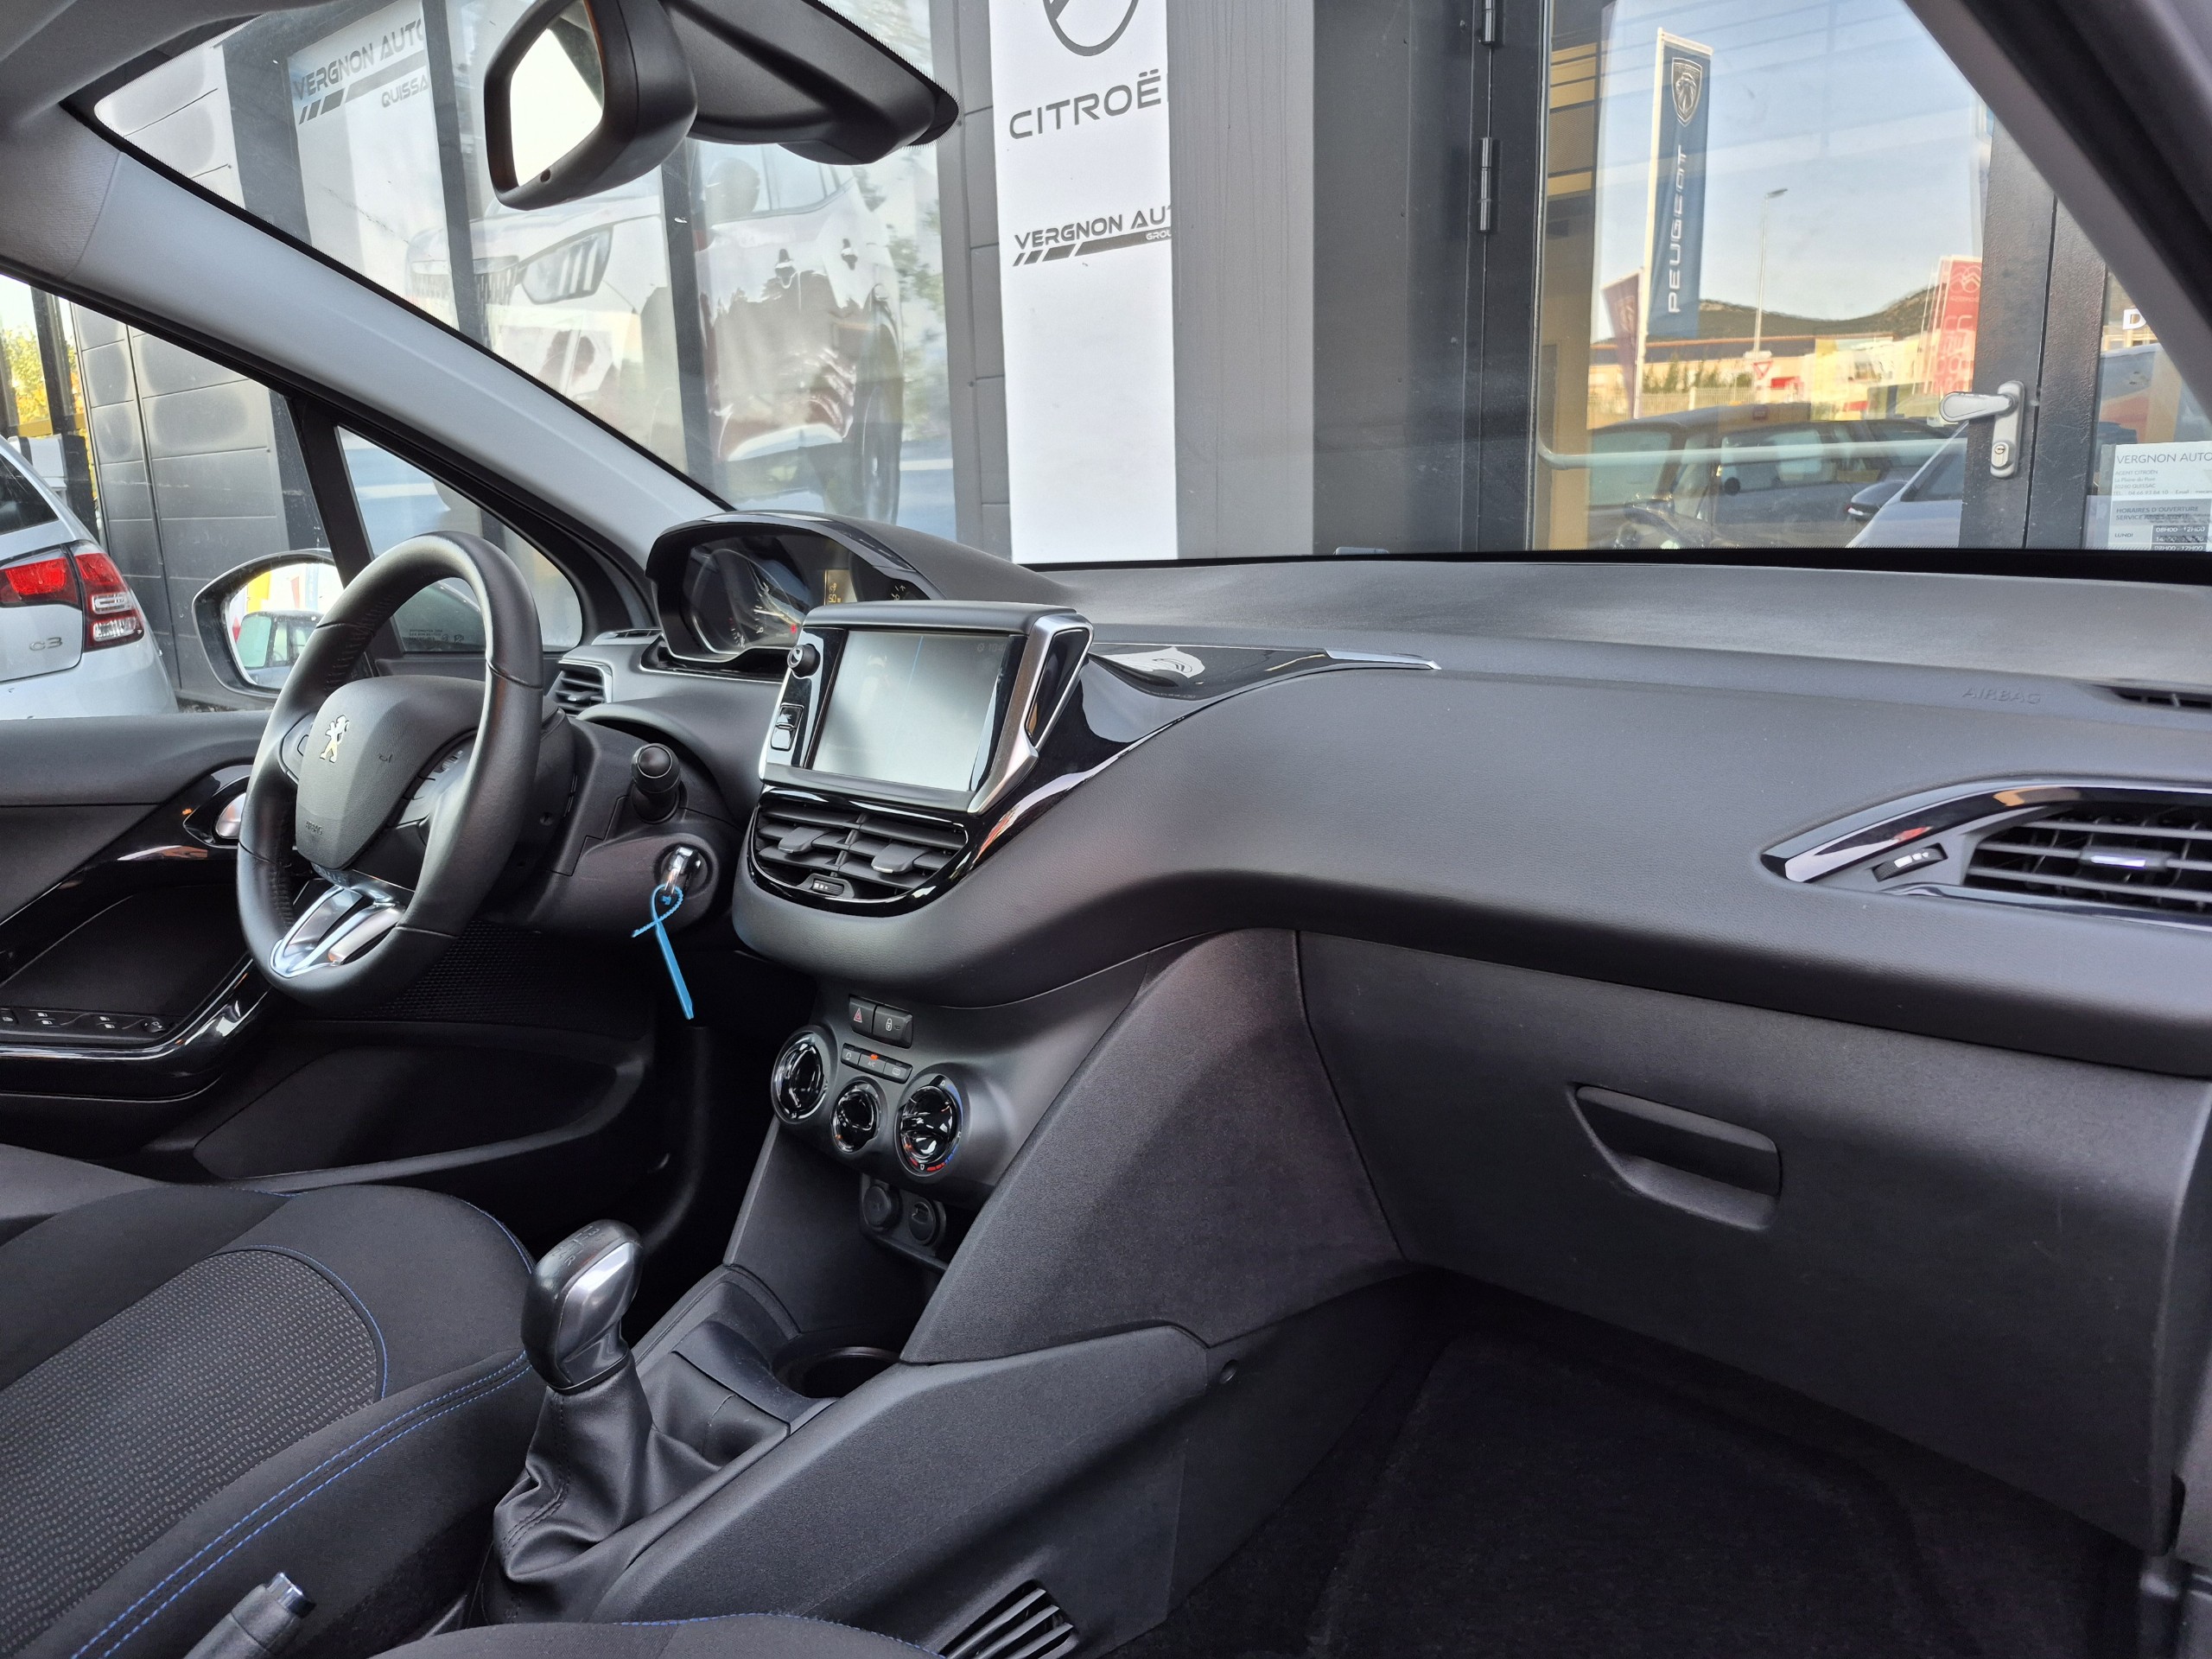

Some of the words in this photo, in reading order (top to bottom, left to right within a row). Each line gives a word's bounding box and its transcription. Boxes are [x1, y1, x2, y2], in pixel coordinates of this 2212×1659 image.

[294, 42, 374, 100] VERGNON
[1009, 68, 1162, 140] CITROË
[1014, 213, 1123, 250] VERGNON
[1130, 205, 1172, 230] AU
[2116, 454, 2177, 464] VERGNON
[1961, 688, 2041, 704] AIRBAG
